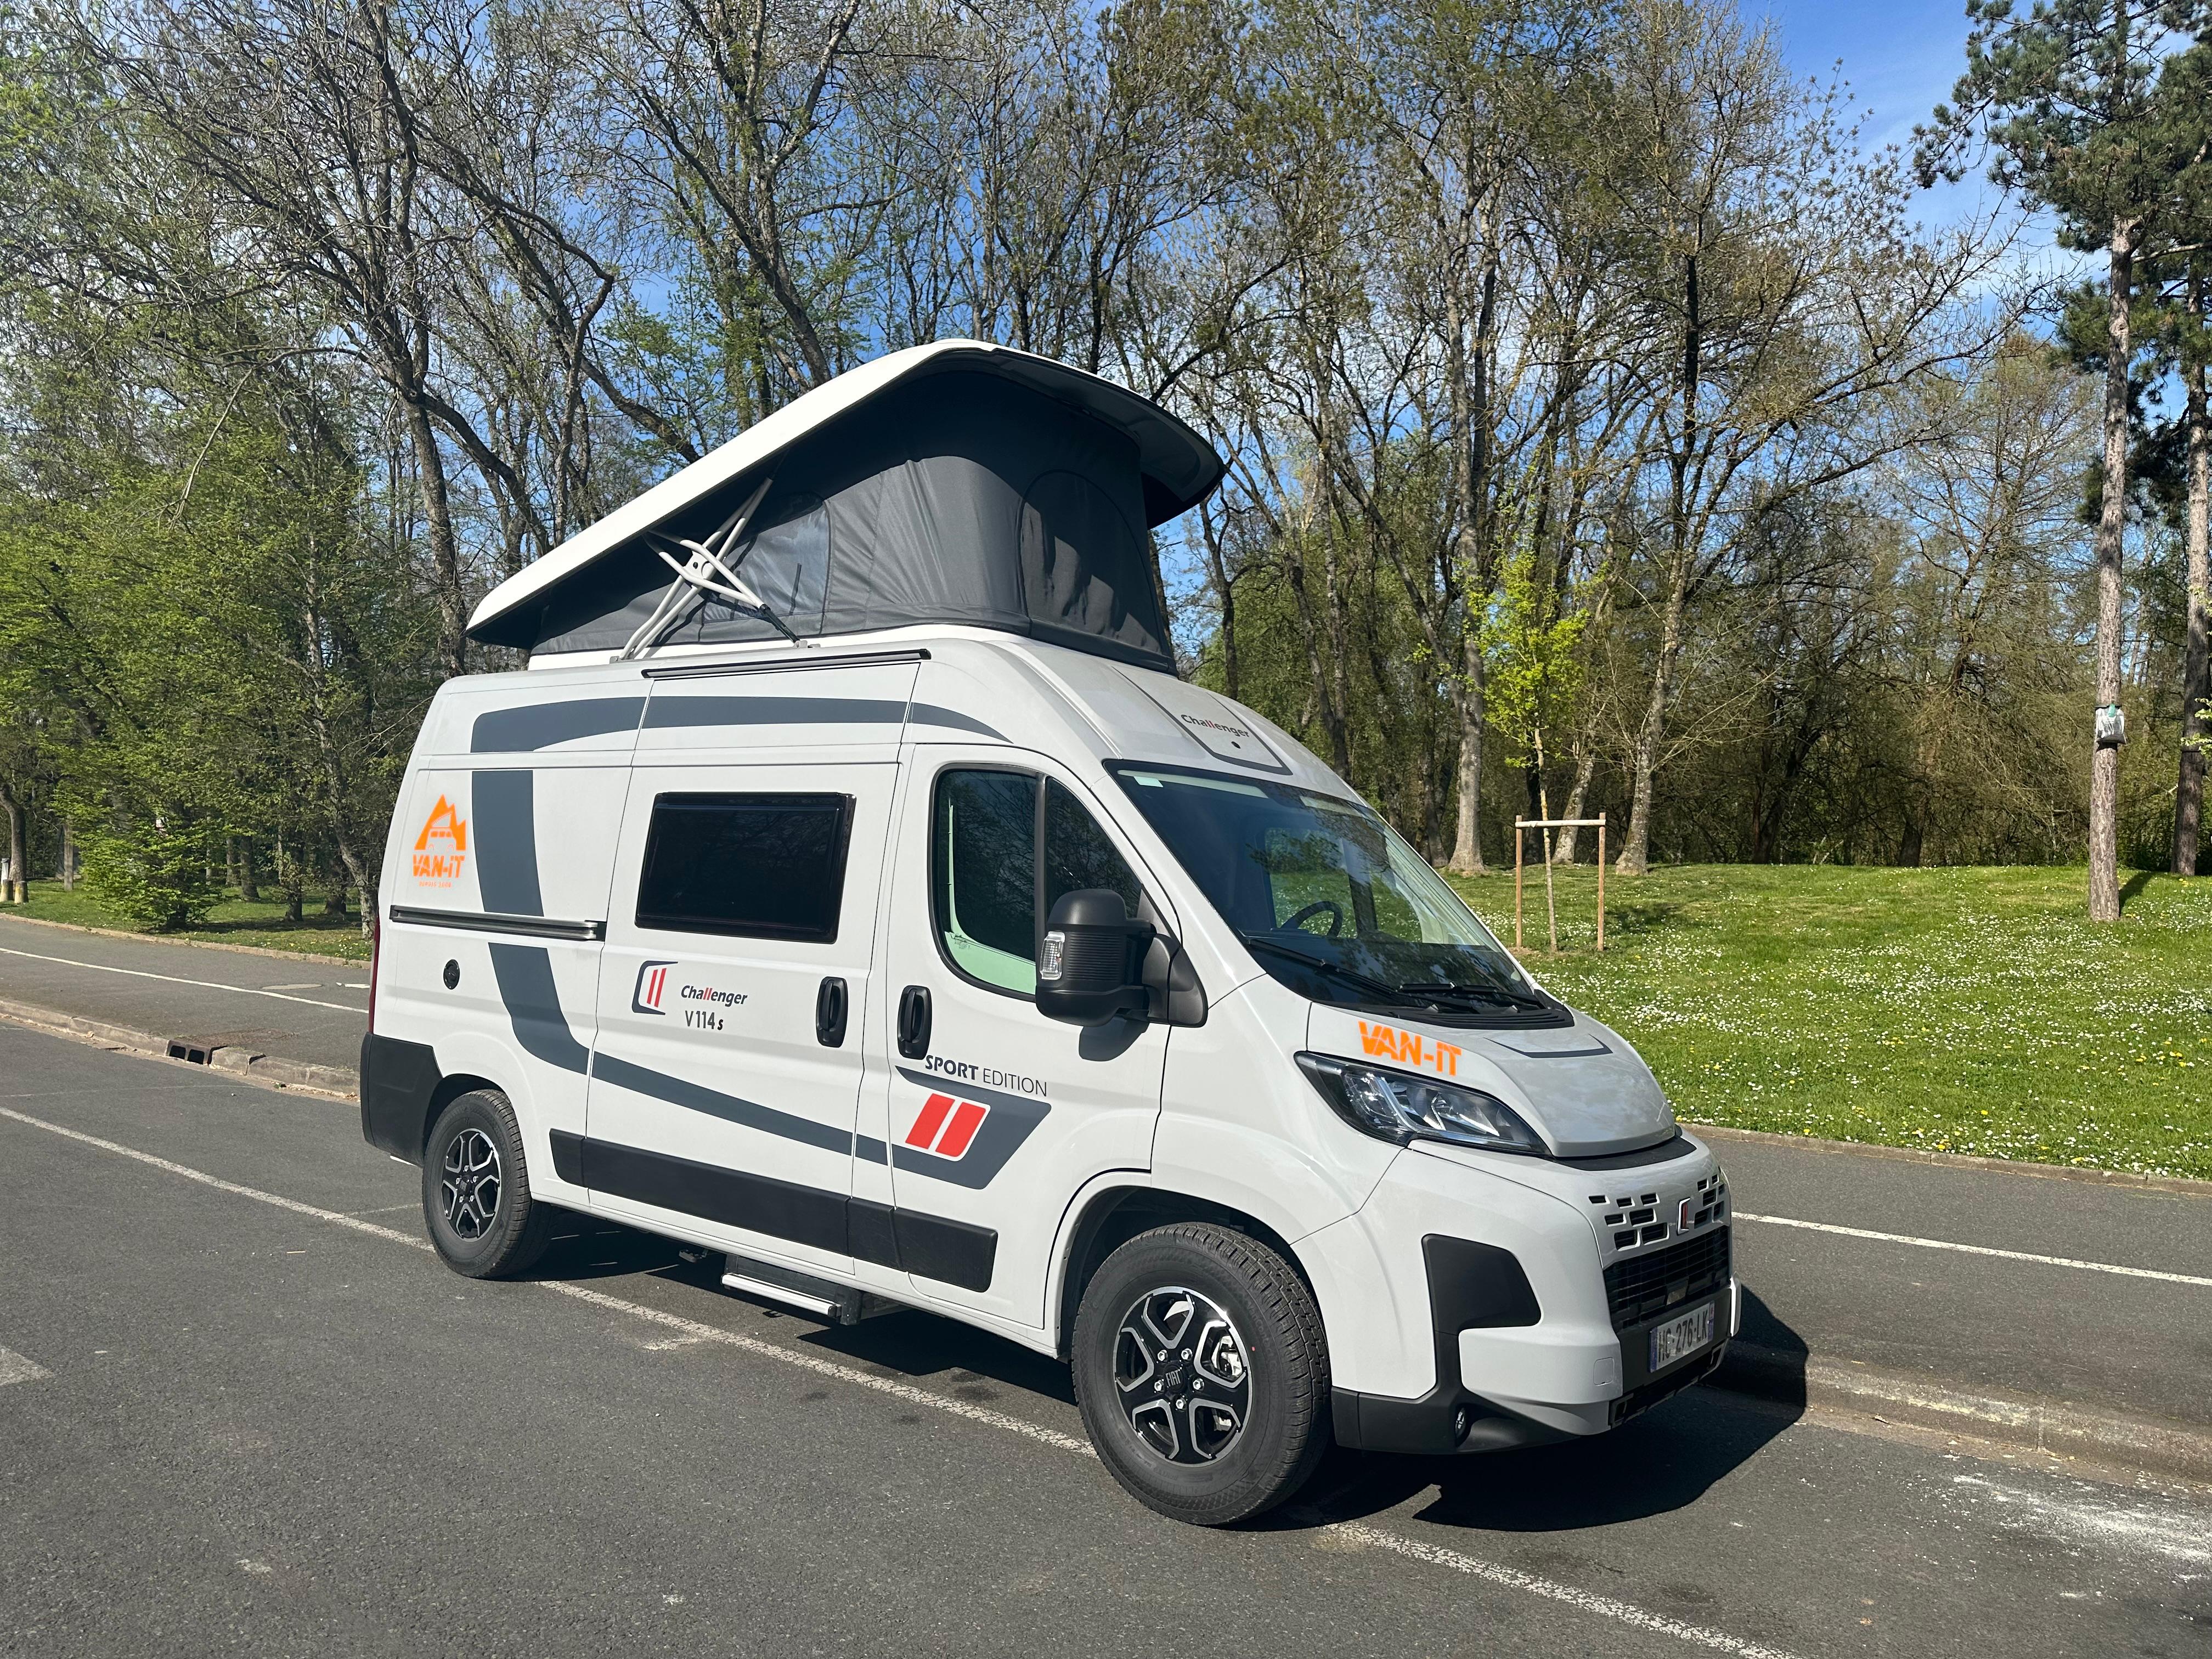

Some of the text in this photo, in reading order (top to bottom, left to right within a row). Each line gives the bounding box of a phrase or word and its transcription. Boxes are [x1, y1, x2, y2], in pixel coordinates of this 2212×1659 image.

[1181, 714, 1250, 737] Challenger
[681, 985, 748, 1007] Challenger
[925, 1054, 1047, 1097] SPORT EDITION
[1165, 1369, 1181, 1387] FIAT
